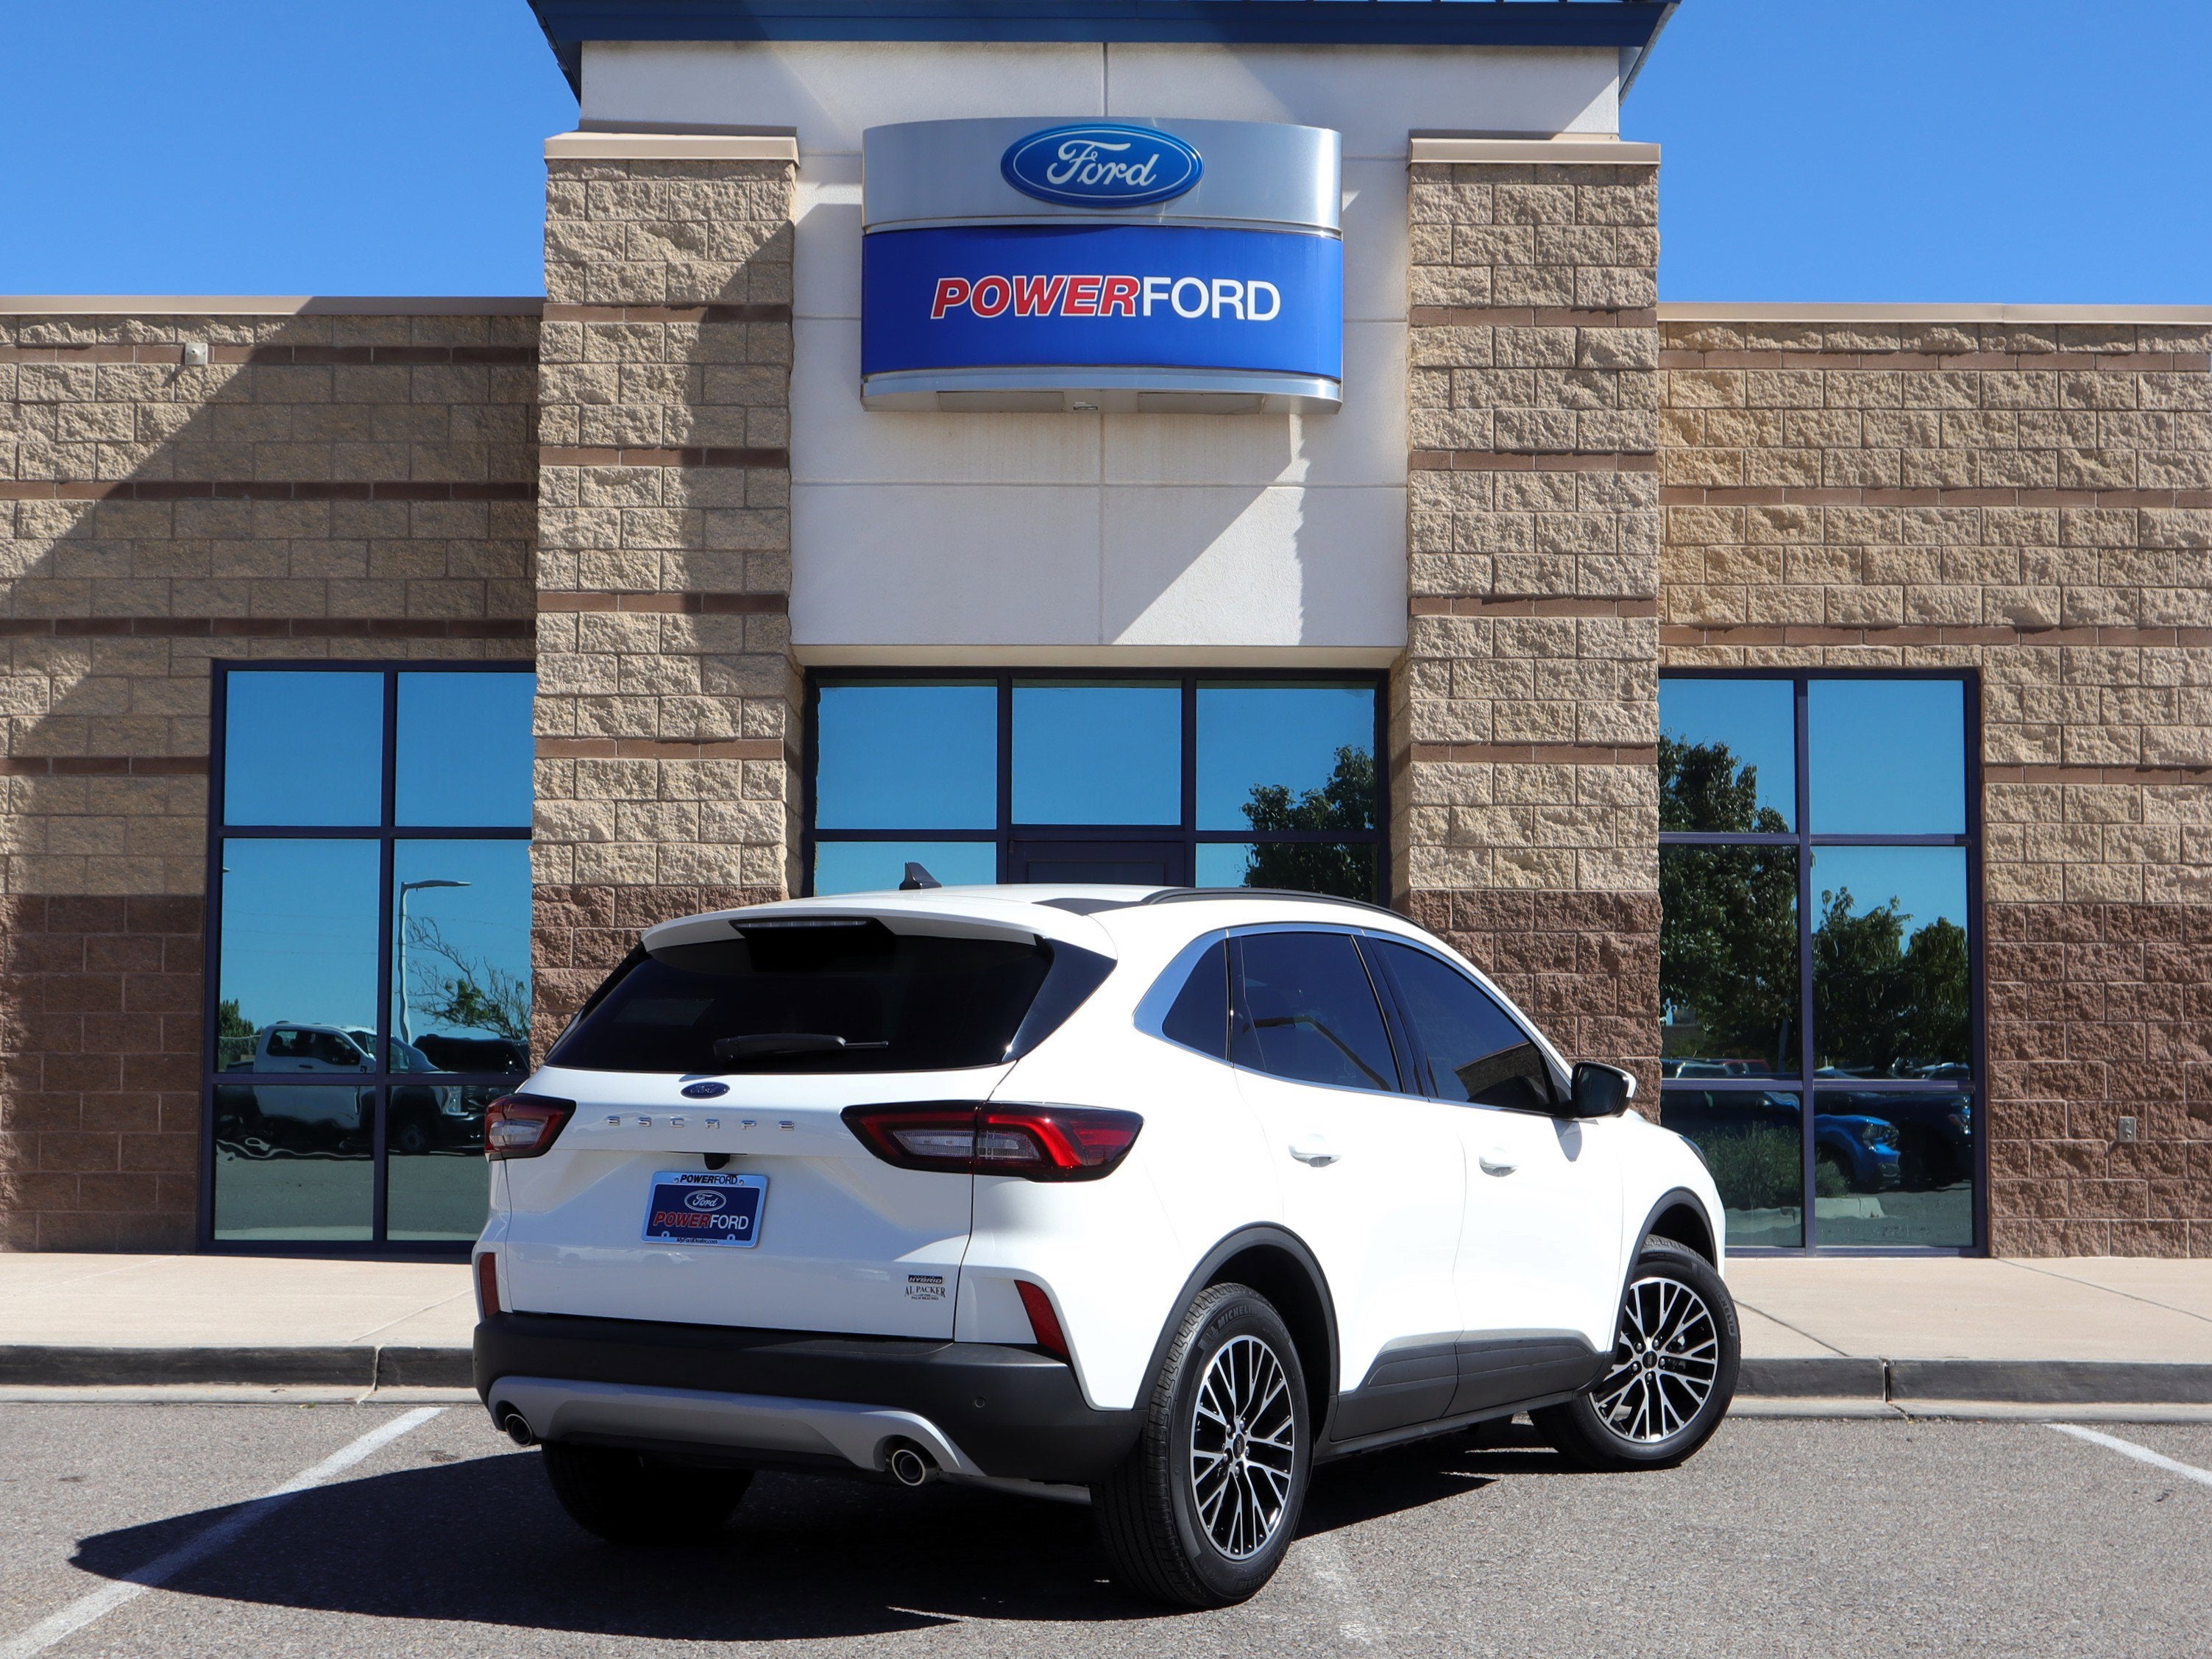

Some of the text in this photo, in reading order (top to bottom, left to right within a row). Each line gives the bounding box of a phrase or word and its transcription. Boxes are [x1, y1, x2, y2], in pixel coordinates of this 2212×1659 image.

[1046, 139, 1159, 187] Ford
[929, 274, 1281, 322] POWERFORD
[606, 1115, 795, 1131] ESCAPE
[679, 1174, 738, 1185] POWERFORD
[692, 1193, 718, 1207] Ford
[653, 1211, 749, 1230] POWERFORD
[904, 1285, 946, 1299] AL PACKER
